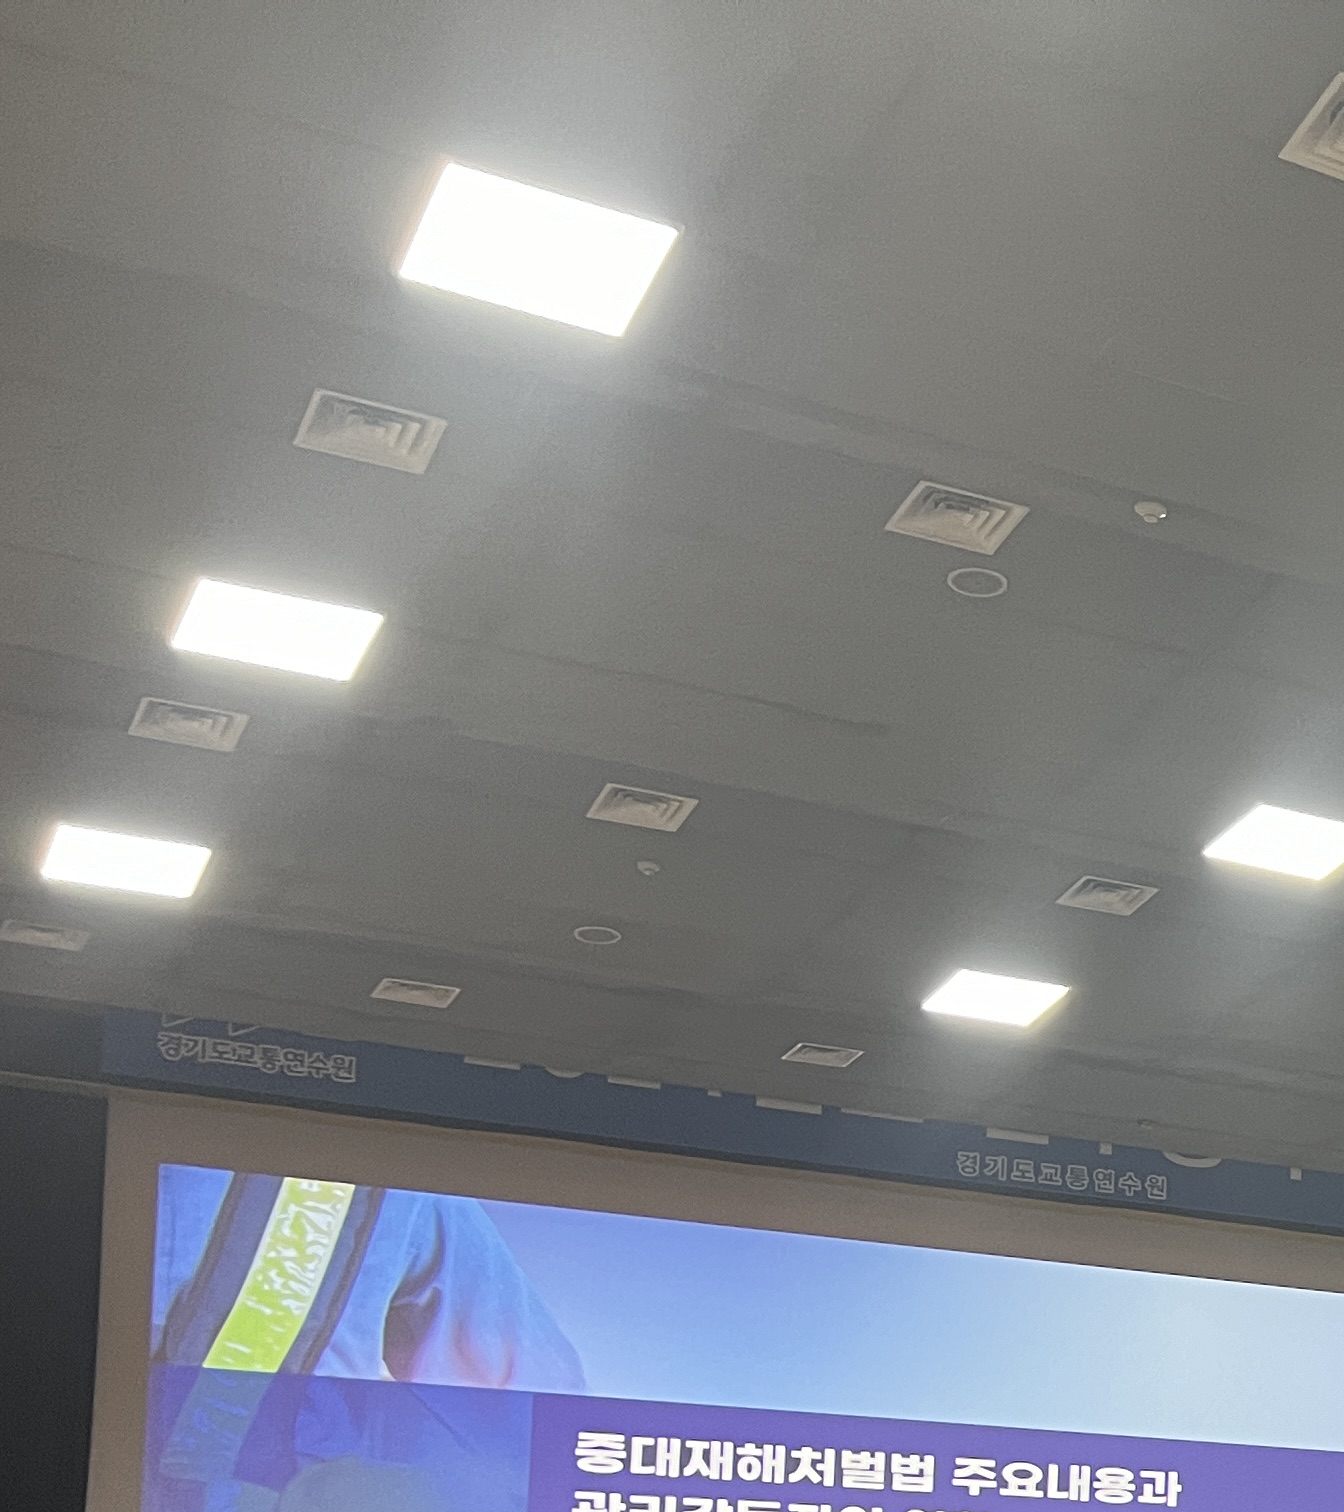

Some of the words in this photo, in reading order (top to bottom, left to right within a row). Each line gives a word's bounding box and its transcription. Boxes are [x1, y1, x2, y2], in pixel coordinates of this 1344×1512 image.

[158, 1031, 357, 1083] 경기도교통연수원
[956, 1151, 1168, 1200] 경기도교통연수원
[573, 1430, 936, 1494] 중대재해처벌법
[951, 1456, 1183, 1508] 주요내용과
